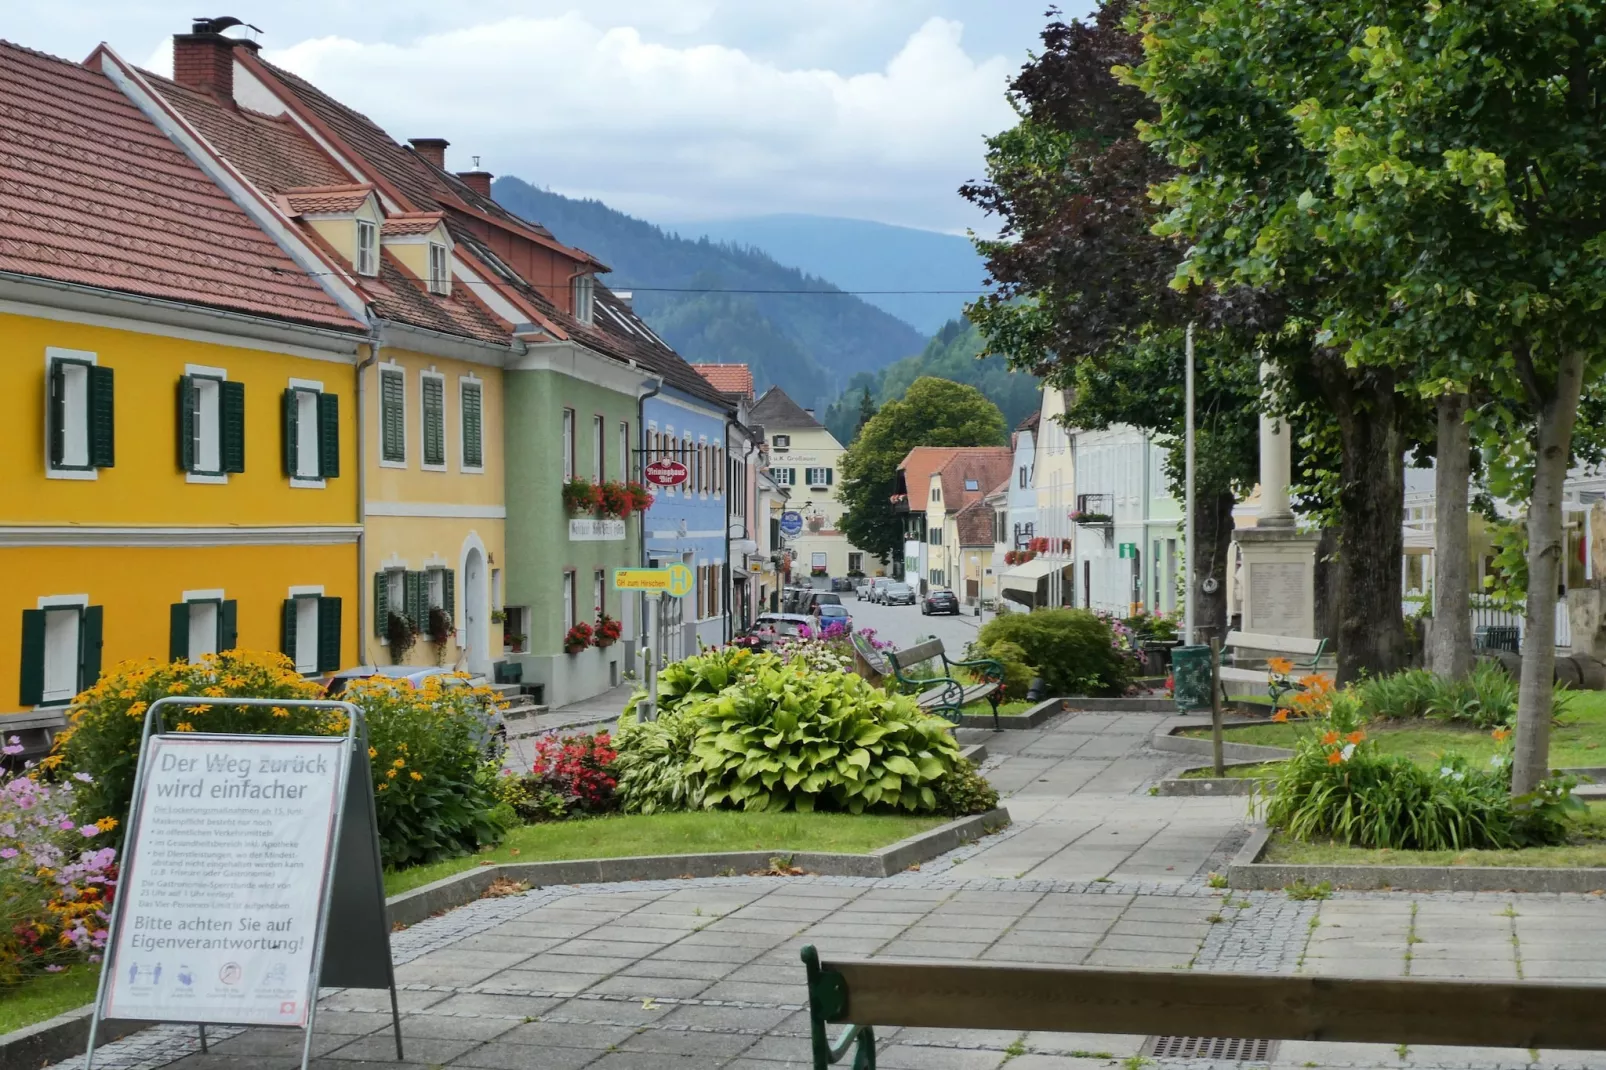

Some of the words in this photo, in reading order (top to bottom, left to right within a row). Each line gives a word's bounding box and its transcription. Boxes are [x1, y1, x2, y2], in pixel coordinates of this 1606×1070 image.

[671, 570, 686, 590] H
[161, 754, 198, 772] Der
[206, 754, 252, 778] Weg
[259, 754, 328, 774] zurück
[157, 778, 204, 798] wird
[210, 779, 308, 800] einfacher
[134, 916, 173, 931] Bitte
[178, 916, 233, 932] achten
[238, 917, 262, 932] Sie
[266, 917, 294, 932] auf
[131, 934, 304, 955] Eigenverantwortung!
